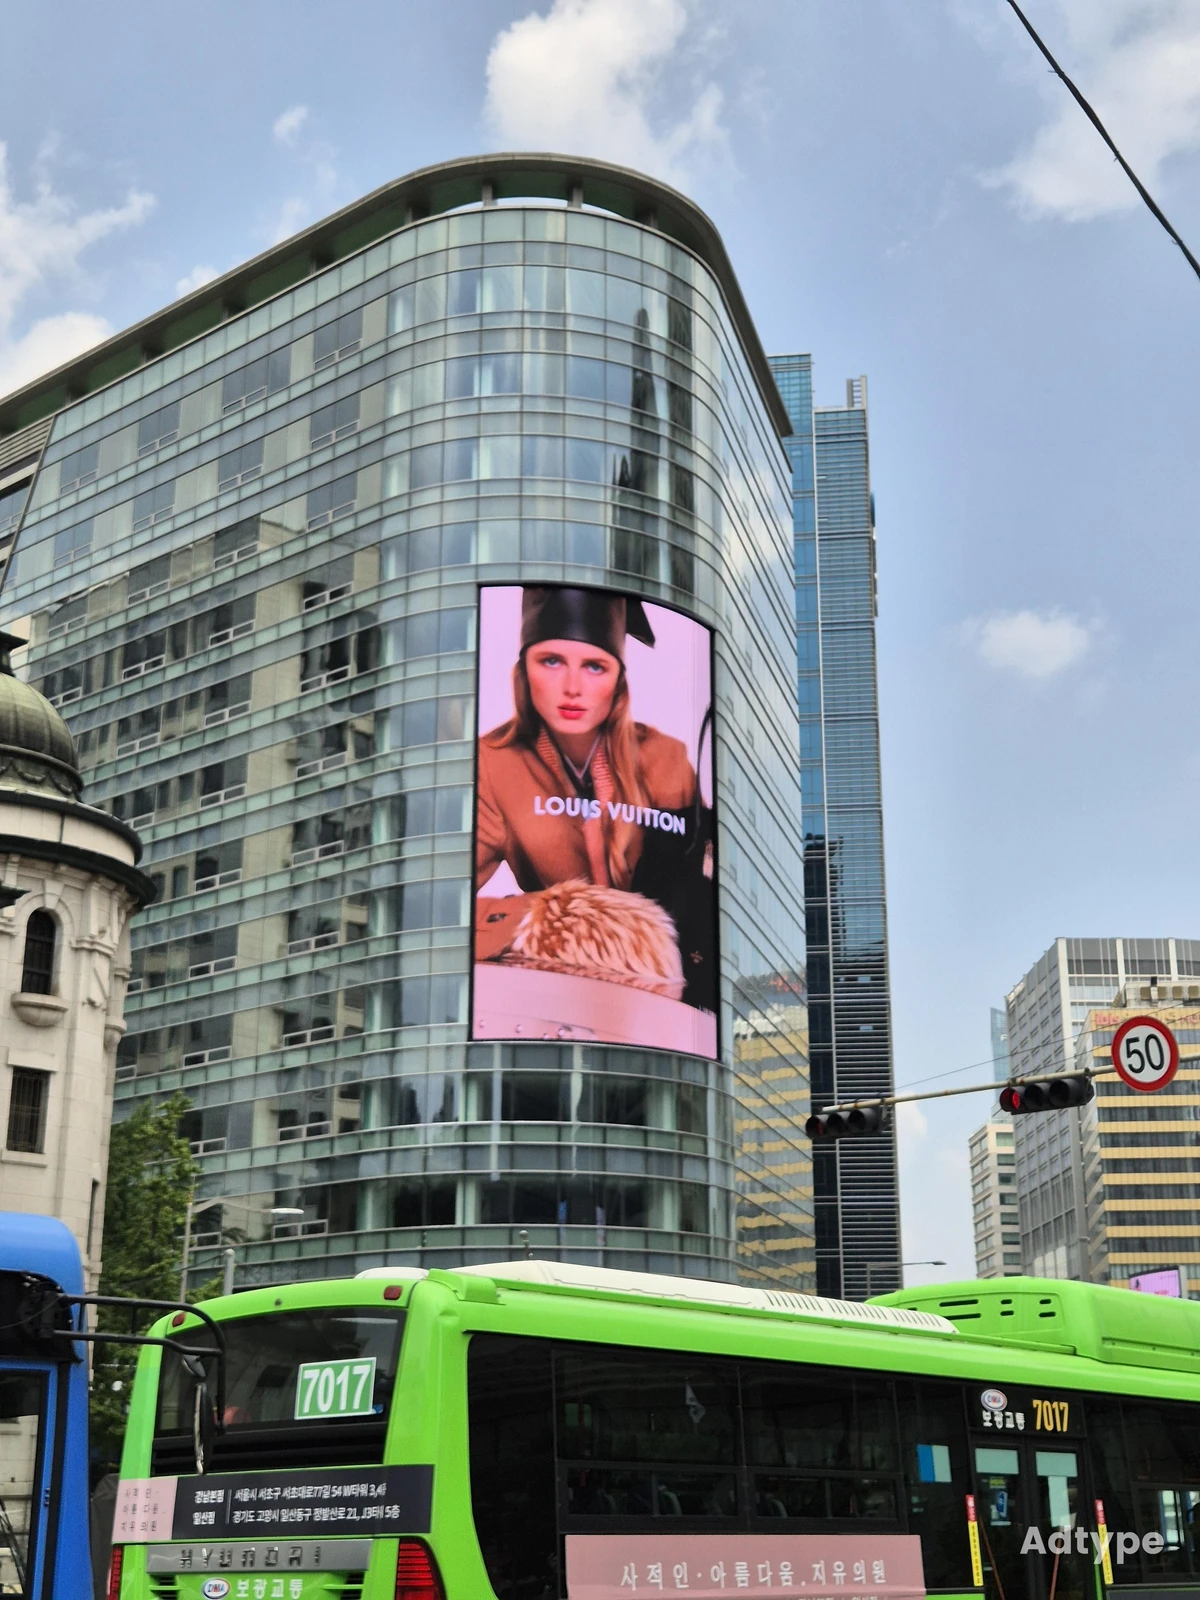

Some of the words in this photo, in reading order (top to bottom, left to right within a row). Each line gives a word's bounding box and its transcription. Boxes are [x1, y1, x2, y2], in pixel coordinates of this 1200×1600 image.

[534, 795, 602, 819] LOUIS
[607, 801, 686, 836] VUITTON
[1125, 1033, 1165, 1073] 50
[303, 1365, 371, 1413] 7017
[1032, 1399, 1069, 1432] 7017
[234, 1487, 258, 1501] 서울시
[258, 1486, 281, 1500] 서초구
[193, 1511, 215, 1525] 일산점
[232, 1510, 255, 1523] 경기도
[256, 1509, 279, 1522] 고양시
[280, 1507, 312, 1522] 일산동구
[236, 1578, 304, 1599] 보광교통
